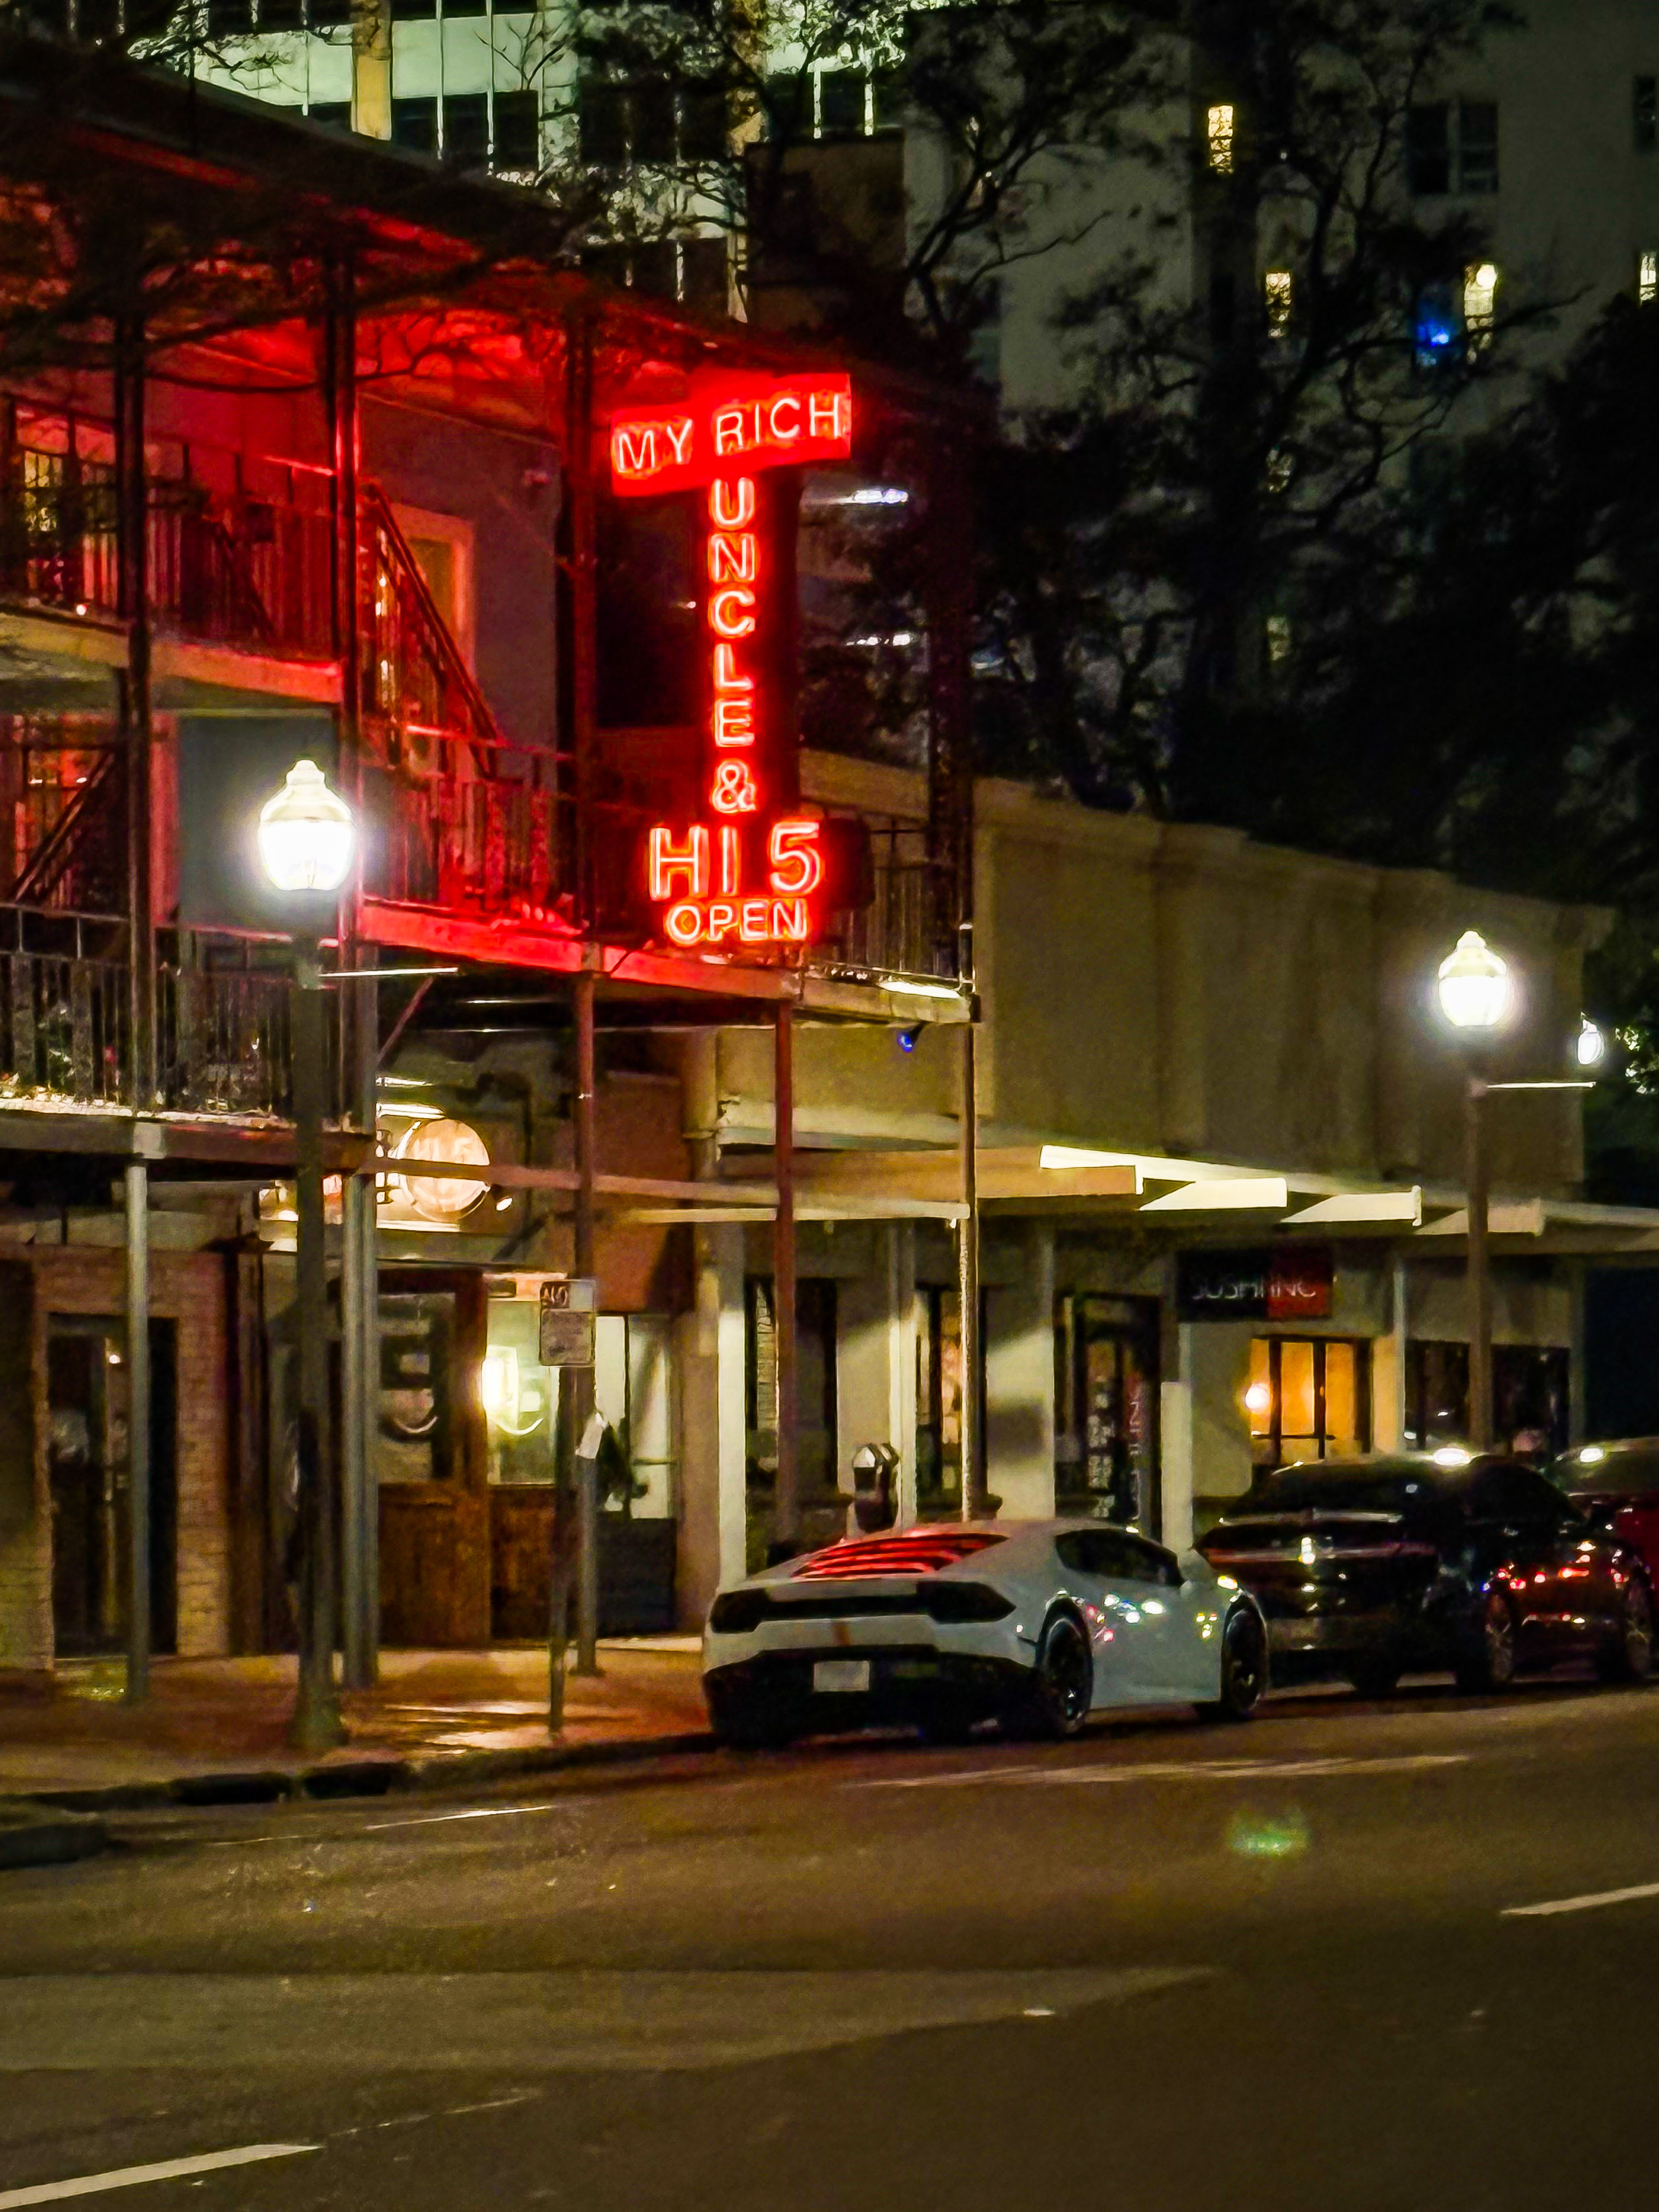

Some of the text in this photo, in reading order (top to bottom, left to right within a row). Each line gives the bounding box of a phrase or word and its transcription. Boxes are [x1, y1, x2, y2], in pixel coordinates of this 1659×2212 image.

[616, 392, 843, 473] MY RICH
[708, 477, 756, 814] UNCLE &
[649, 821, 821, 900] HI 5
[666, 898, 808, 945] OPEN
